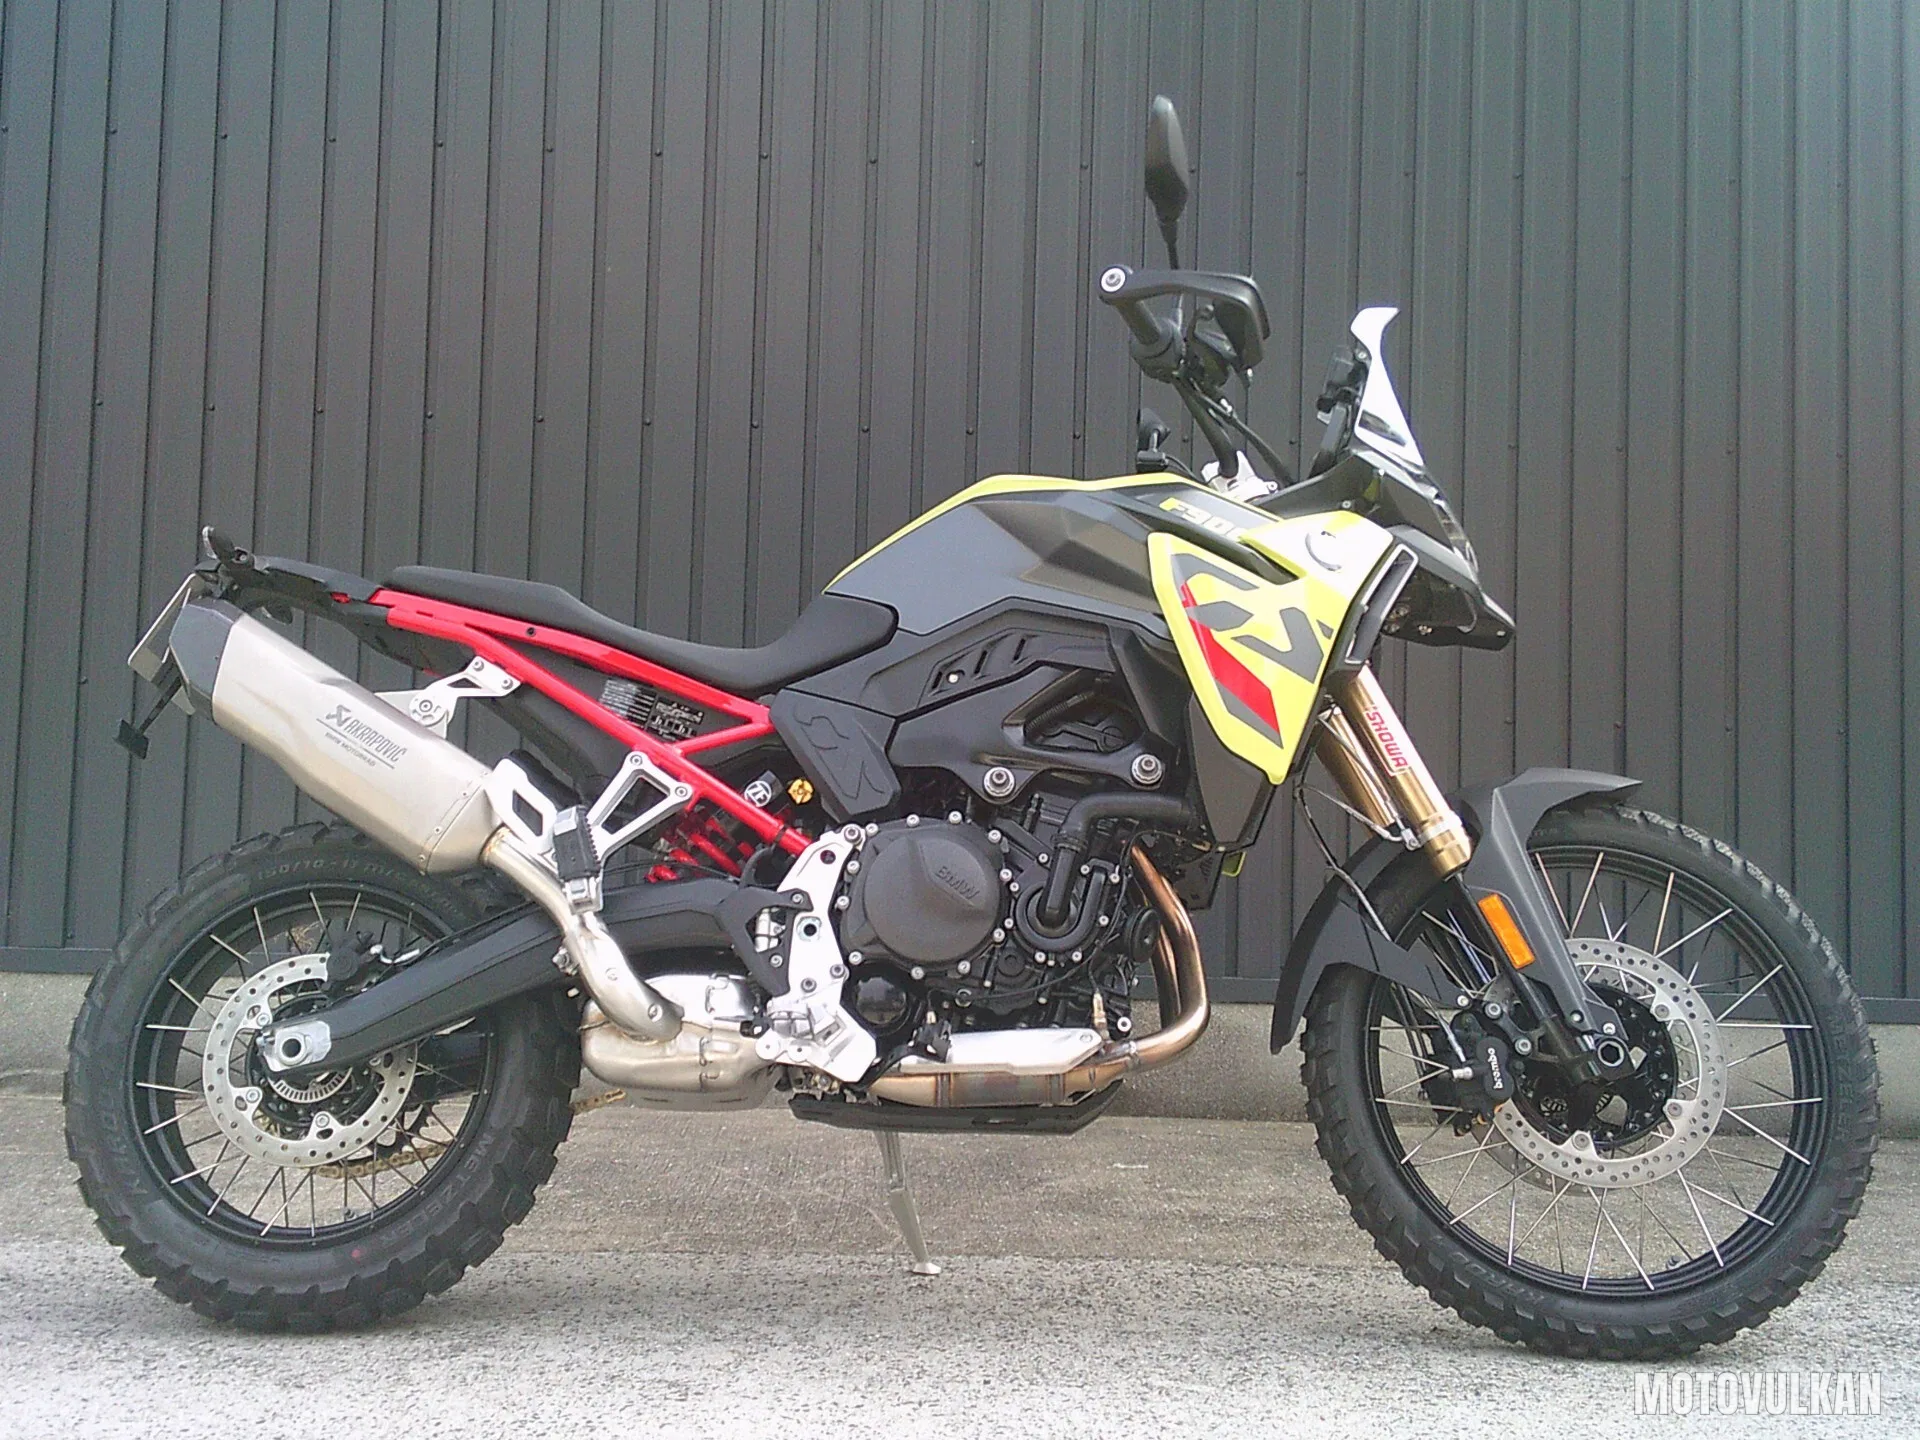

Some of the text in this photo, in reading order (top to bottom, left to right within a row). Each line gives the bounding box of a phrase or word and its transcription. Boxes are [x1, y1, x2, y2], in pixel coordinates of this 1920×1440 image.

[1366, 711, 1409, 768] SHOWA
[746, 783, 770, 806] ZF
[934, 866, 980, 900] BMW
[1487, 1047, 1503, 1090] brembo
